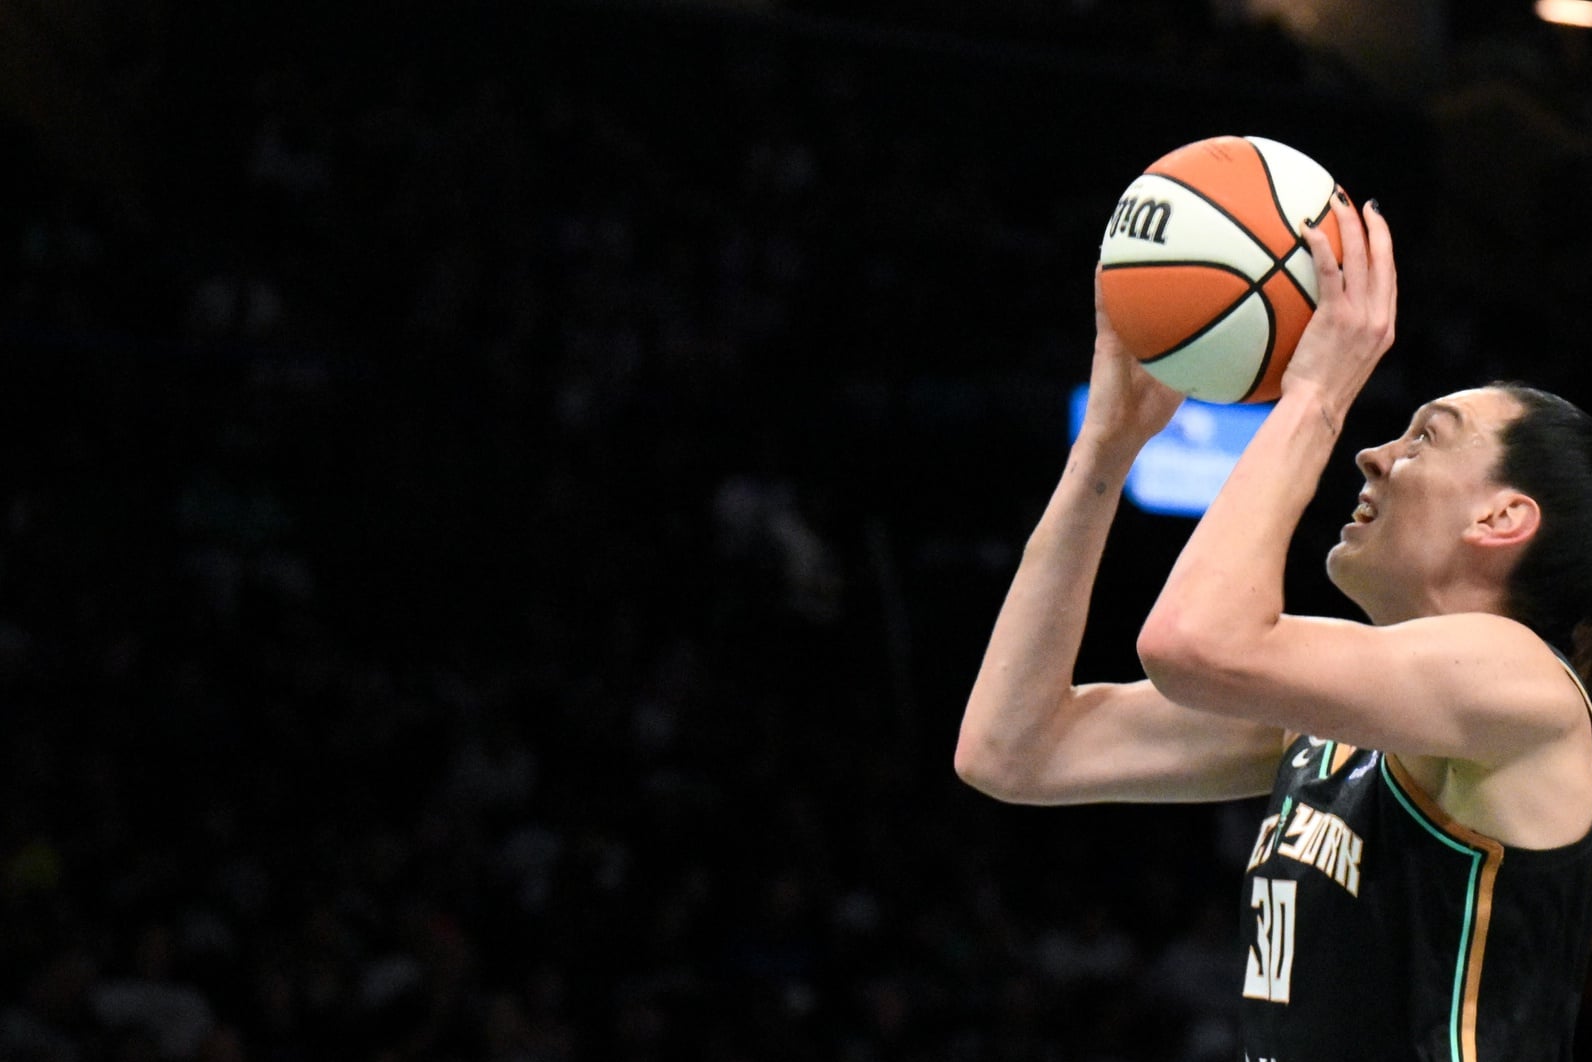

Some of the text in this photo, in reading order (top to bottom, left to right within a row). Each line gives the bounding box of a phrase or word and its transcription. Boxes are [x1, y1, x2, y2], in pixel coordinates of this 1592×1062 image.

[1109, 197, 1172, 245] Wil
[1277, 802, 1364, 899] YORK
[1242, 876, 1297, 1003] 30
